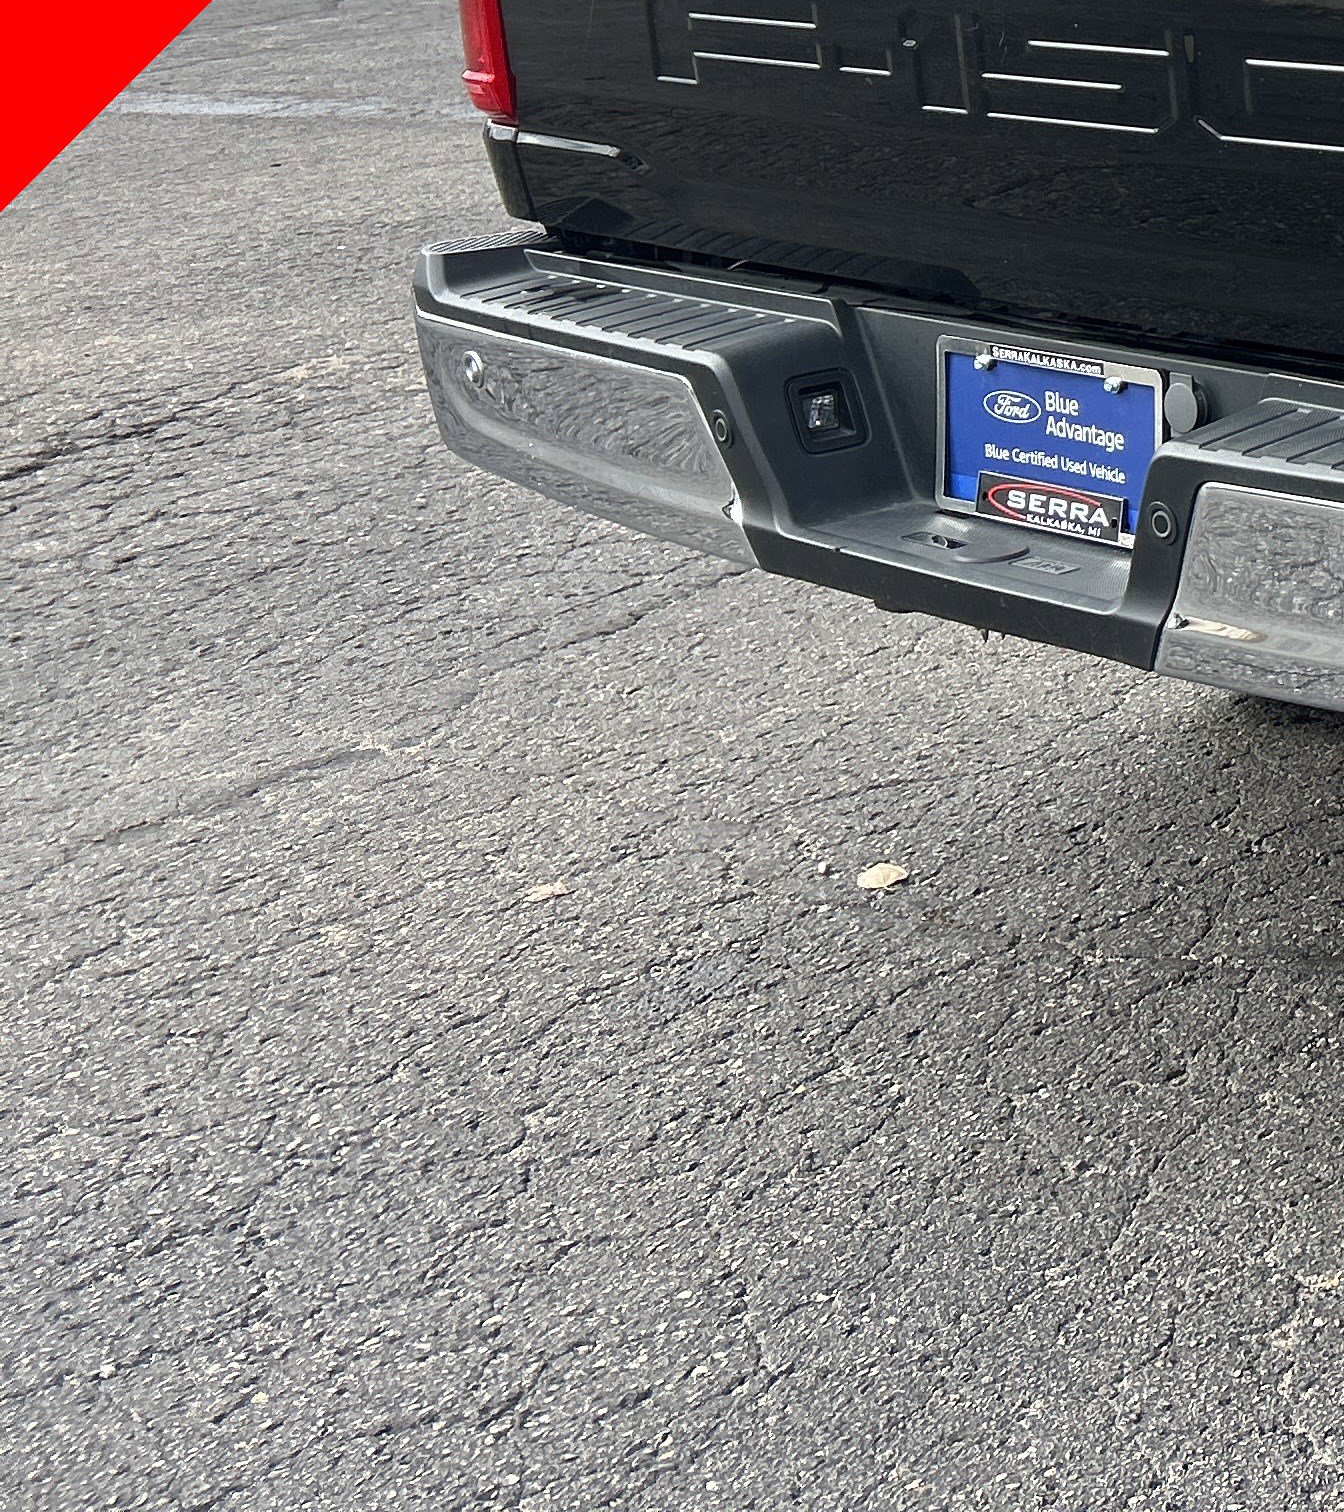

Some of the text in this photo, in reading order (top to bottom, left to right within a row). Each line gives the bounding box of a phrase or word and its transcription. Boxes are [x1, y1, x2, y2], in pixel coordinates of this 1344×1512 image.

[994, 394, 1030, 419] Ford
[1044, 390, 1079, 416] Blue
[1045, 415, 1125, 452] Advantage
[984, 443, 1126, 484] Blue Certified Used Vehicle
[1006, 489, 1110, 527] SERRA
[1026, 513, 1102, 537] KALKASKA, MI
